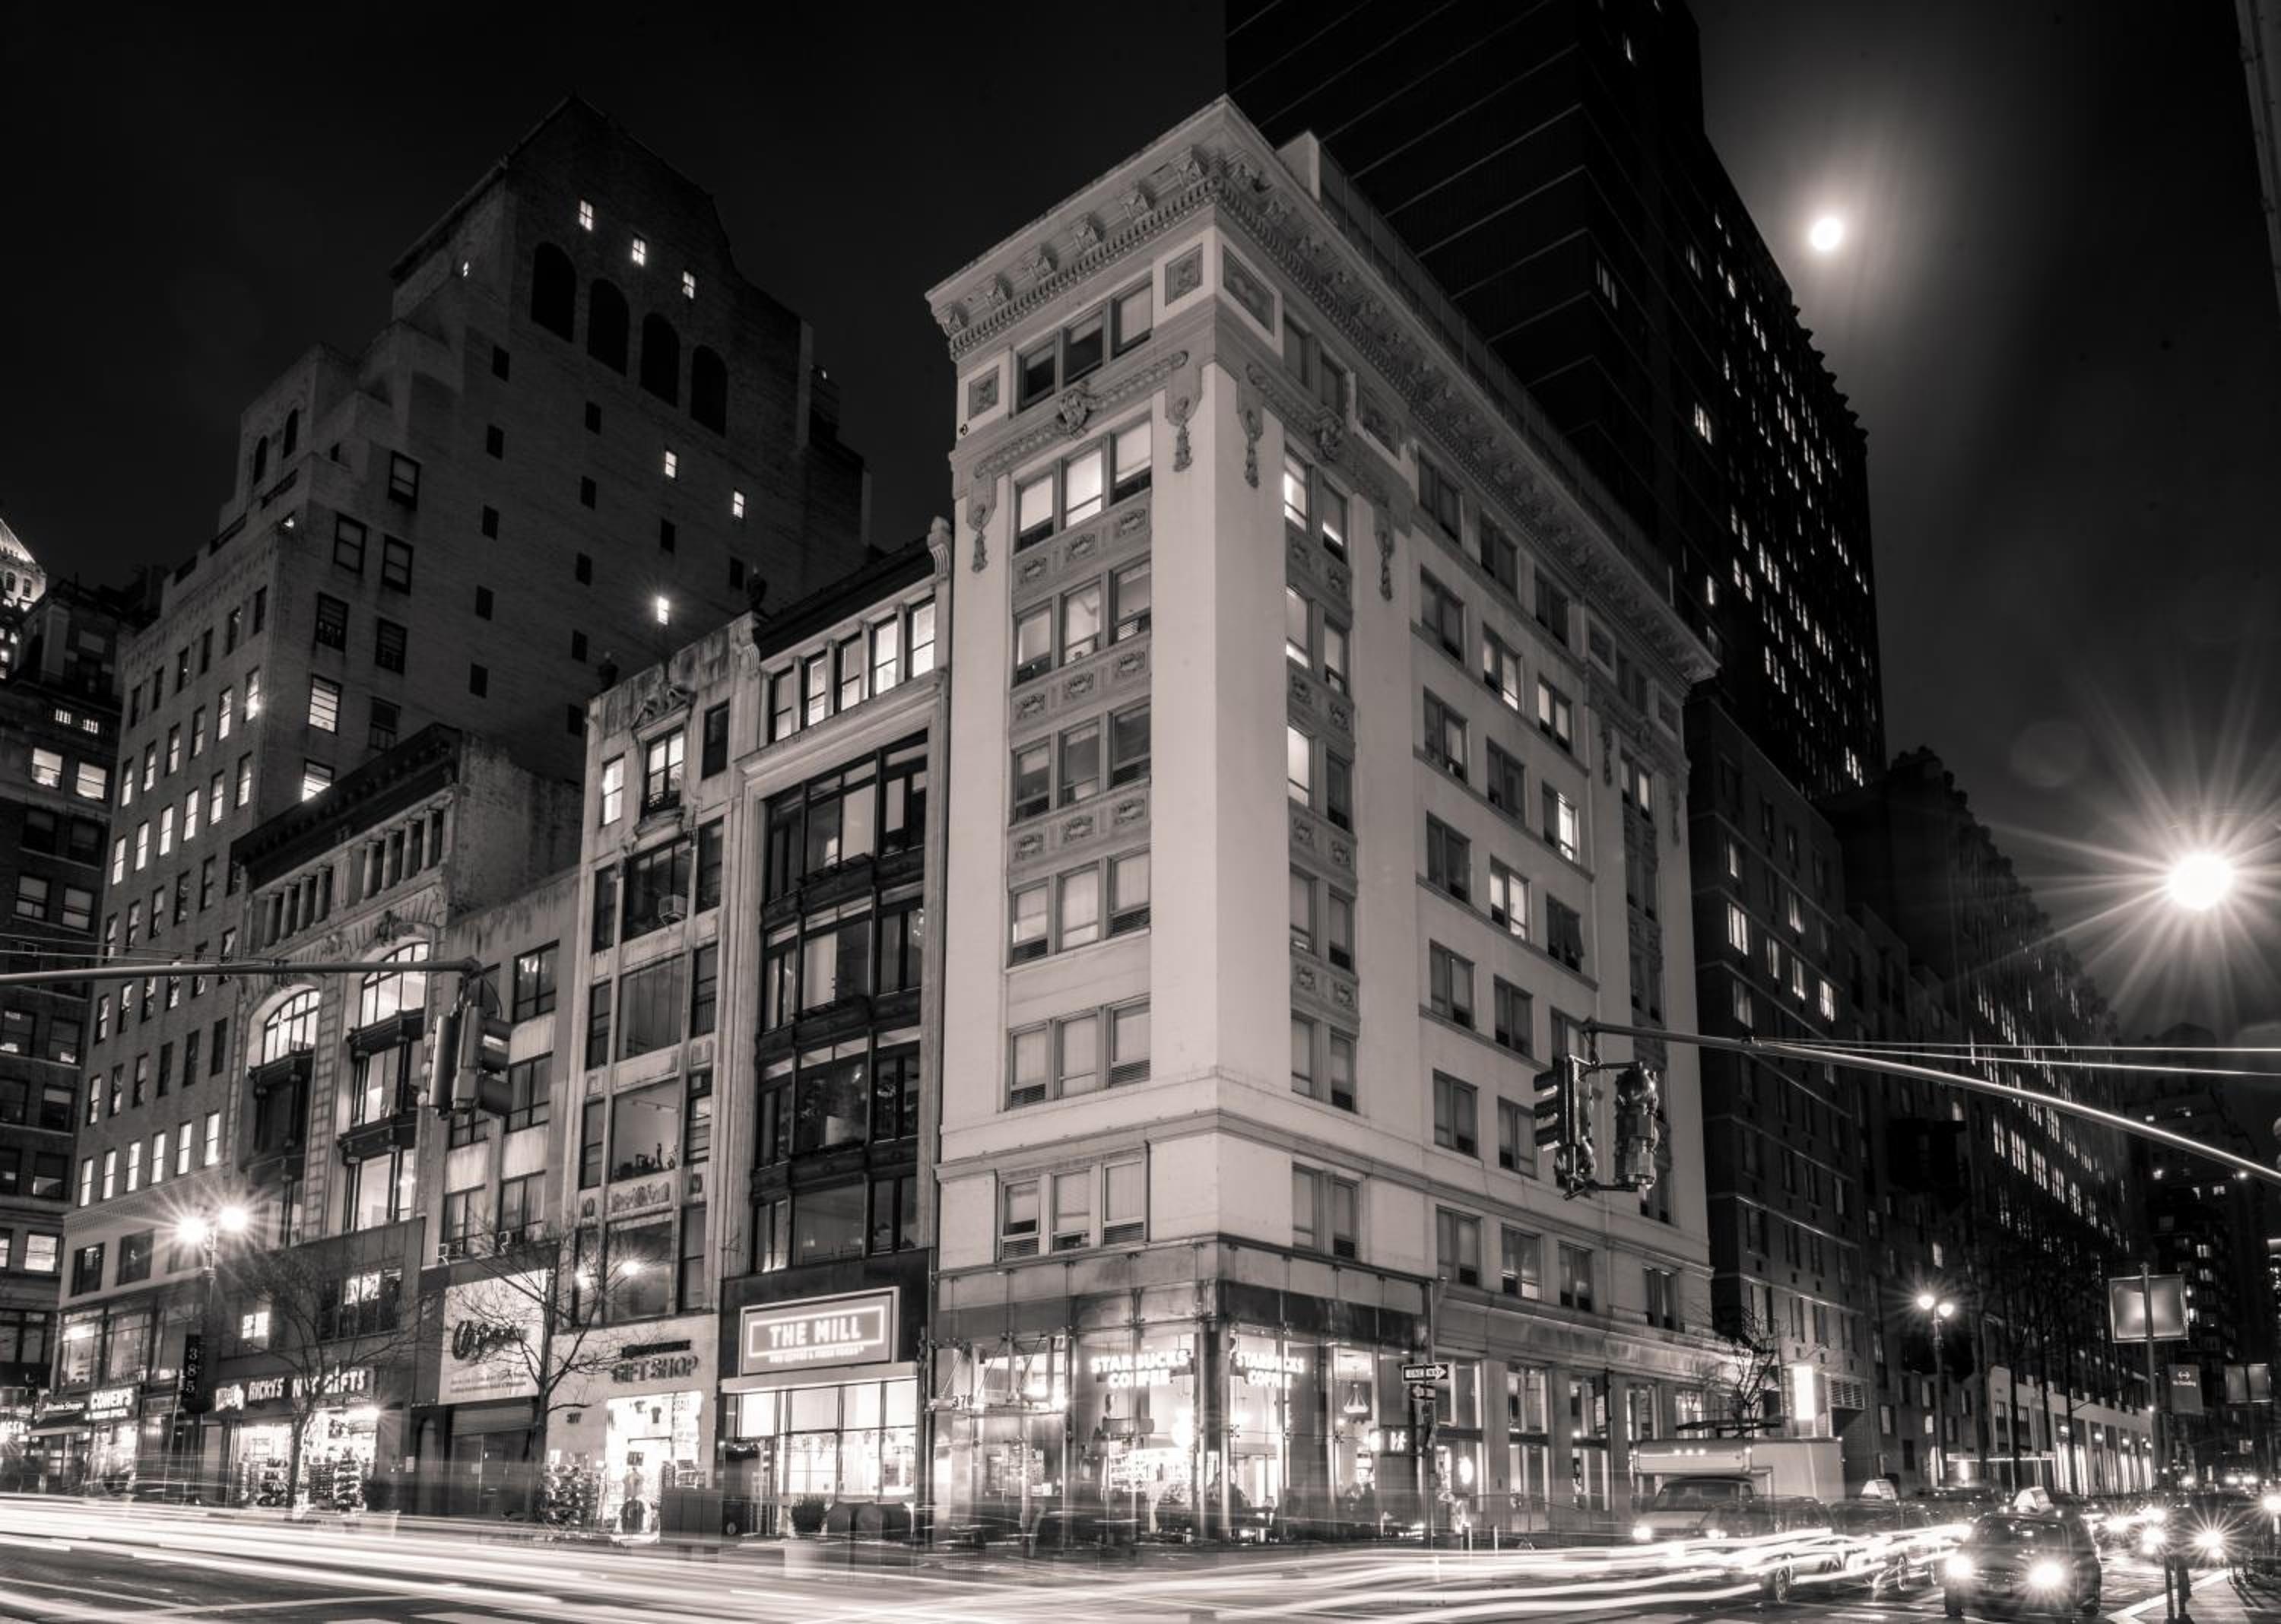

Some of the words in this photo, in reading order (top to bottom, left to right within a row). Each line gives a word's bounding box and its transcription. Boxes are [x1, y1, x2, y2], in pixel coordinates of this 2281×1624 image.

[769, 1321, 807, 1348] THE
[814, 1315, 862, 1343] MILL
[186, 1347, 198, 1394] 385
[649, 1356, 699, 1379] SHOP
[1090, 1350, 1188, 1374] STARBUCKS
[1236, 1351, 1305, 1373] STARBUCKS
[90, 1387, 134, 1410] COHEN'S
